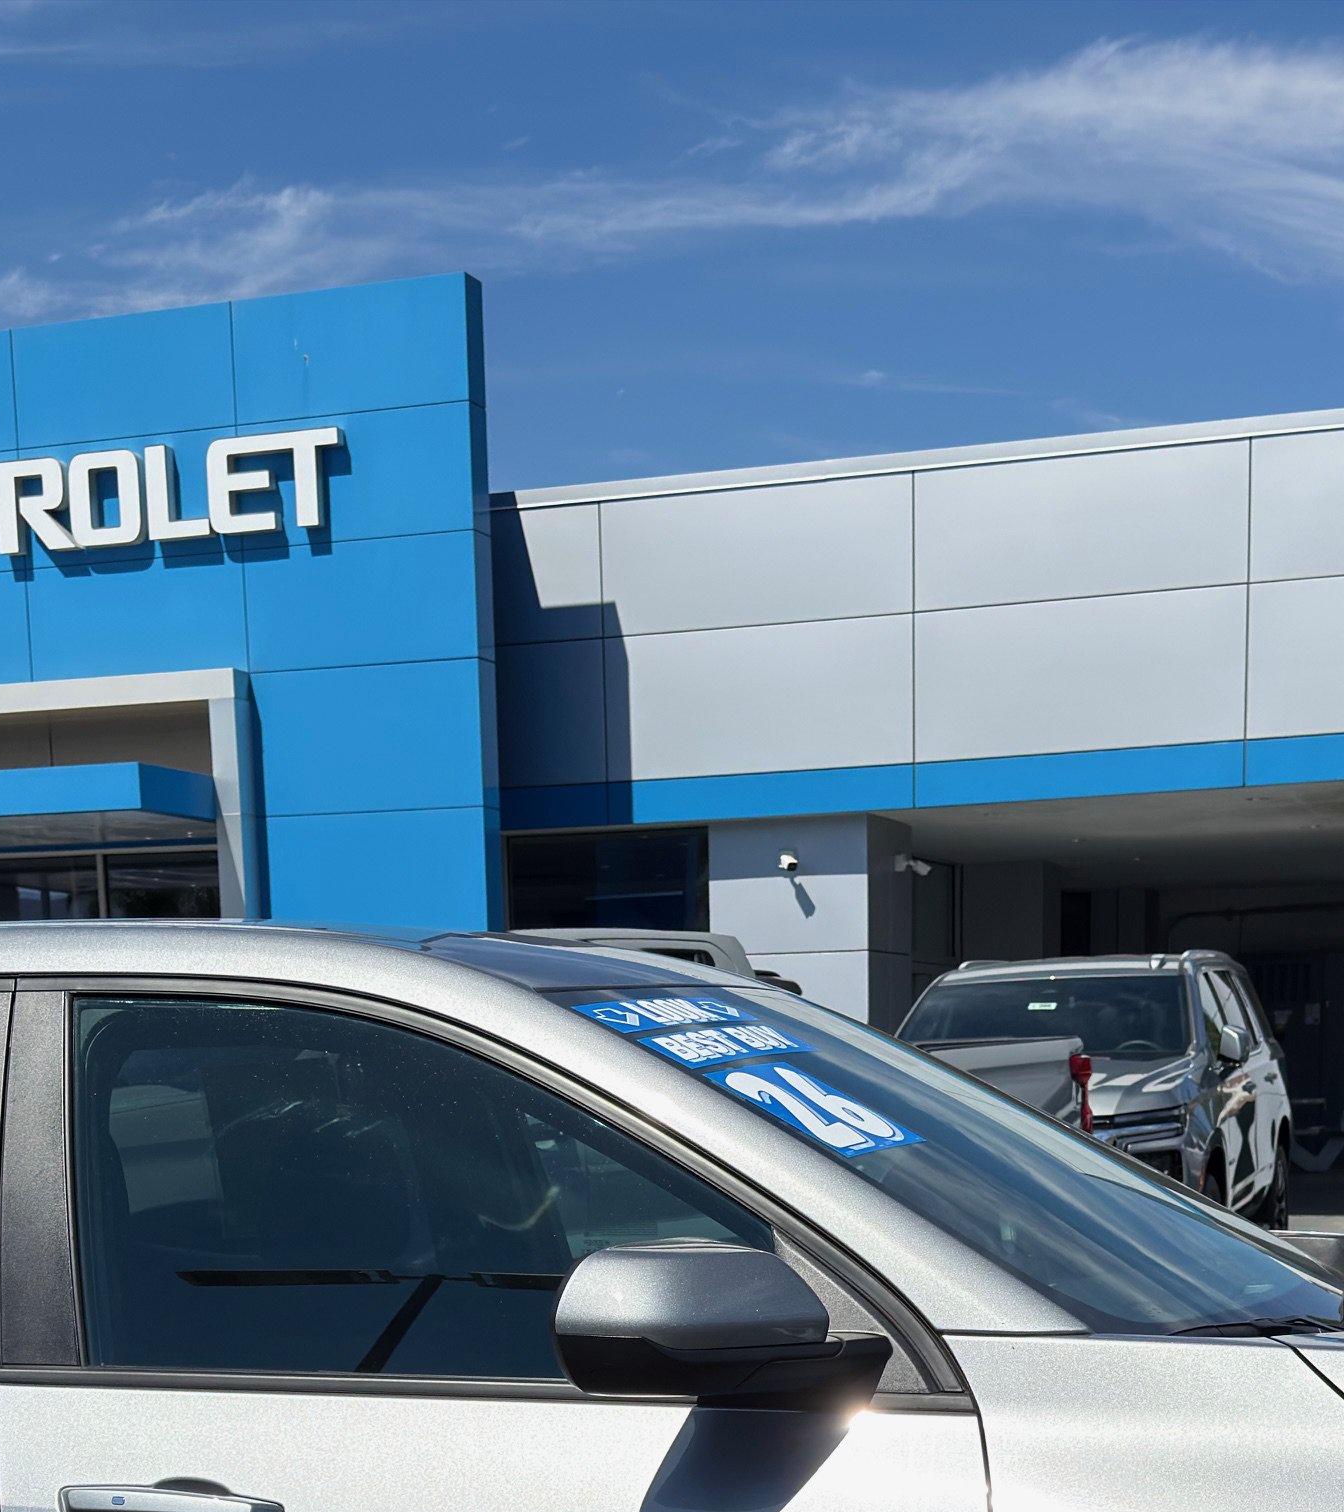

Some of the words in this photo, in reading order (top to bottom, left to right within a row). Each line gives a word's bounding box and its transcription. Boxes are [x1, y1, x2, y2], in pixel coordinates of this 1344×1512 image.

[619, 998, 727, 1026] LOOK
[652, 1030, 750, 1063] BEST
[721, 1025, 799, 1051] BUY
[725, 1066, 904, 1150] 26
